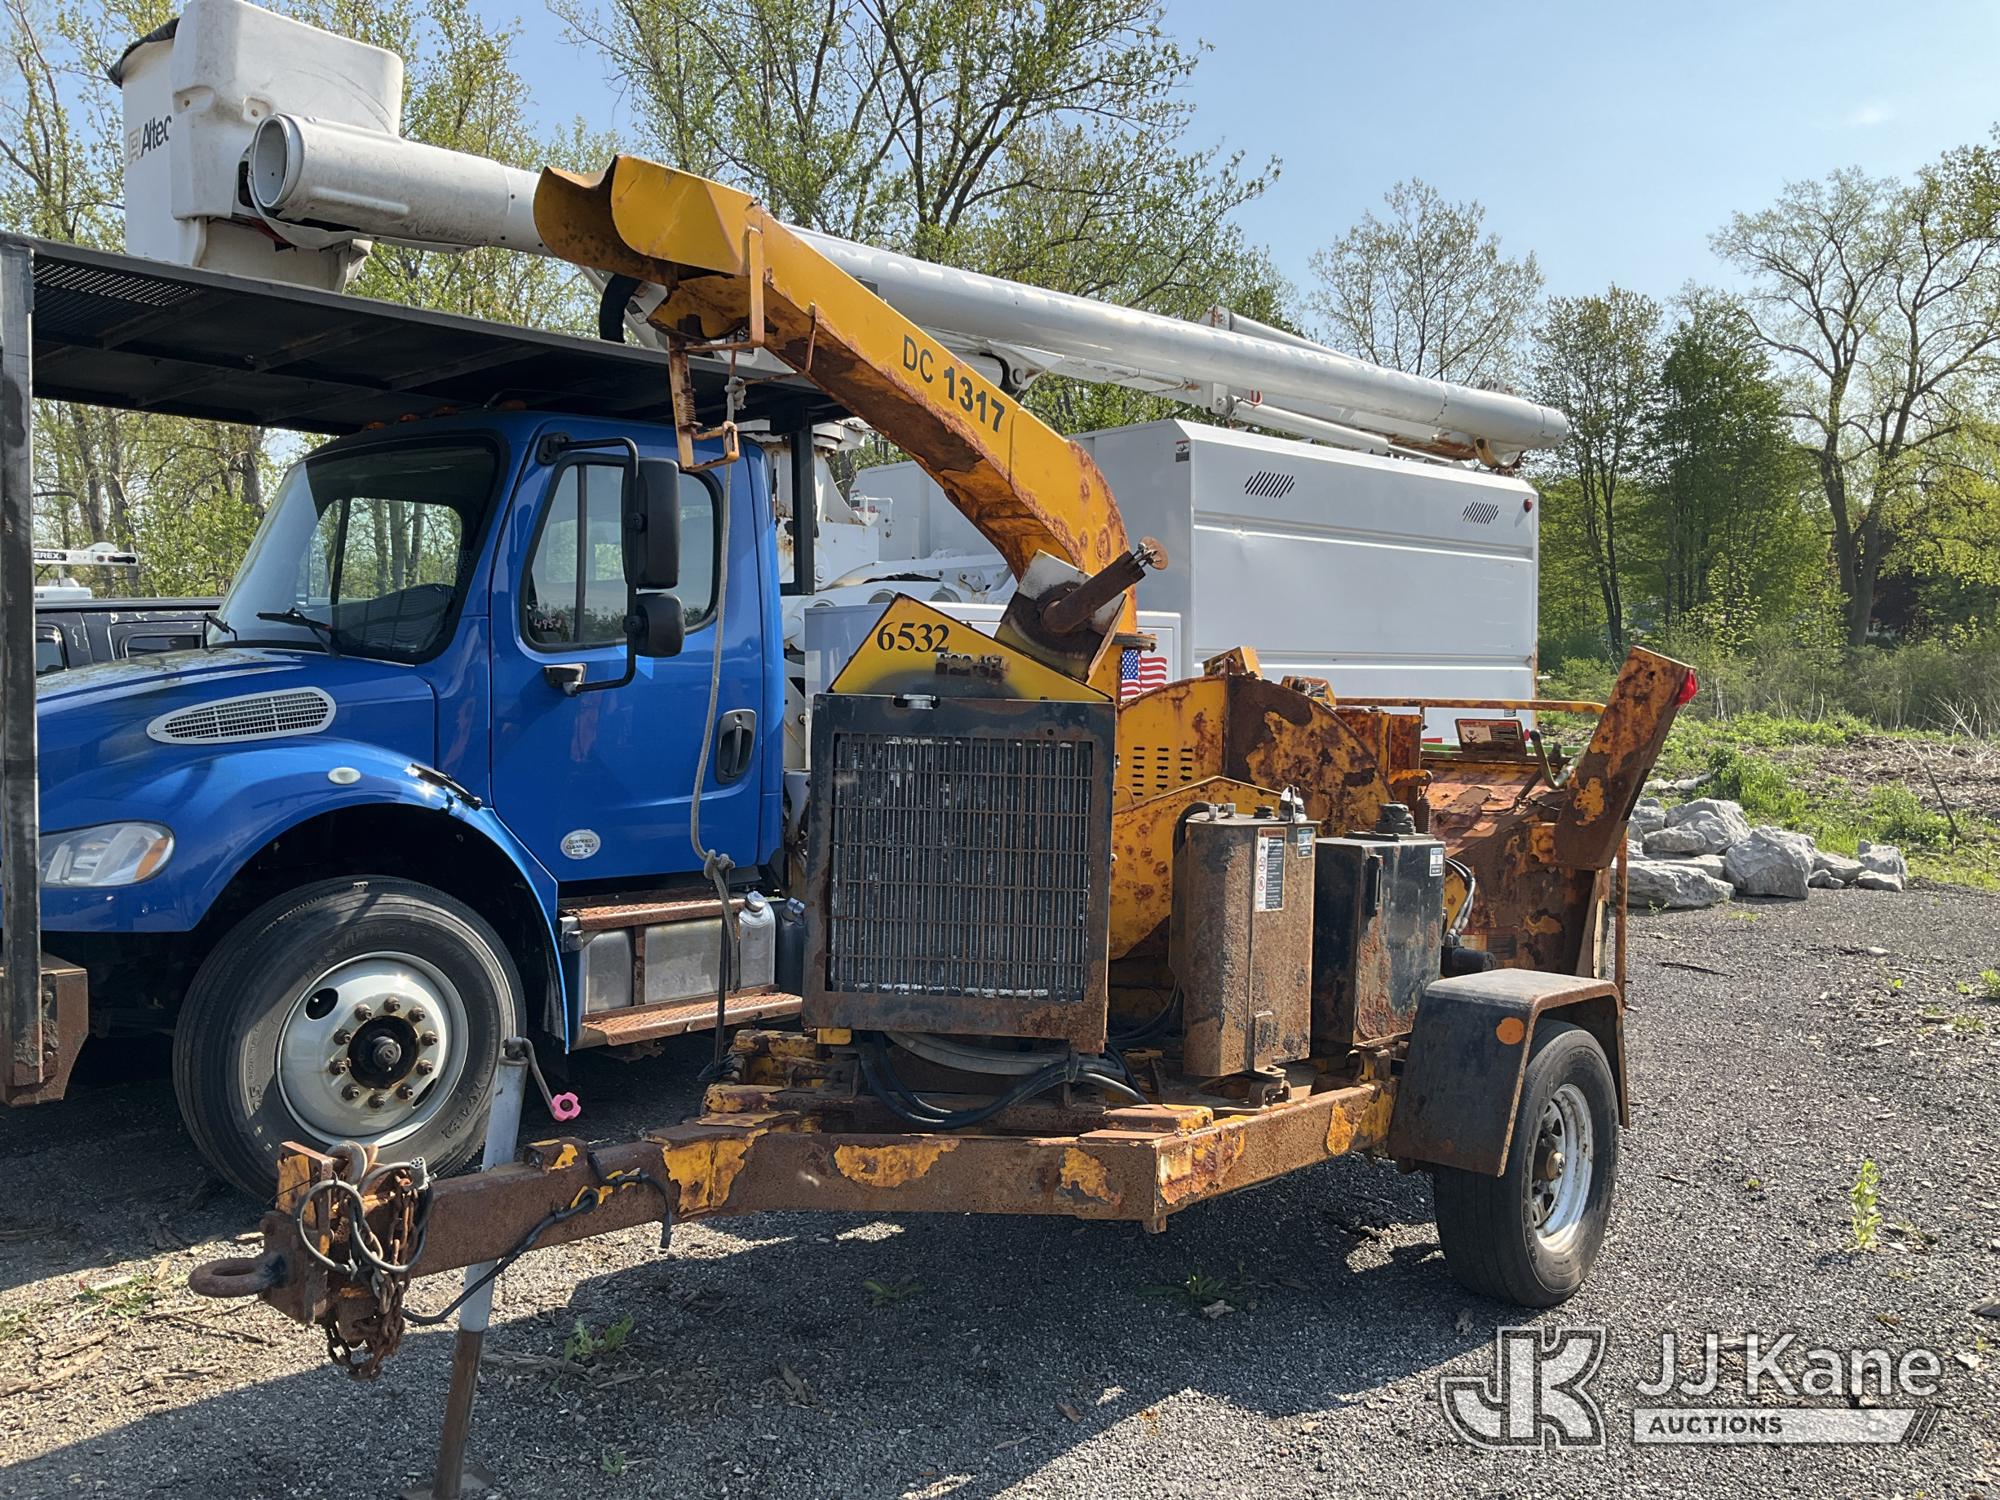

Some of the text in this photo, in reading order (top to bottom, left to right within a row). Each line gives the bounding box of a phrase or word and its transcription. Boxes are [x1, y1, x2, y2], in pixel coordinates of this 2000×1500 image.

[141, 115, 172, 157] Altec
[903, 334, 1005, 433] DC 1317
[876, 621, 950, 653] 6532
